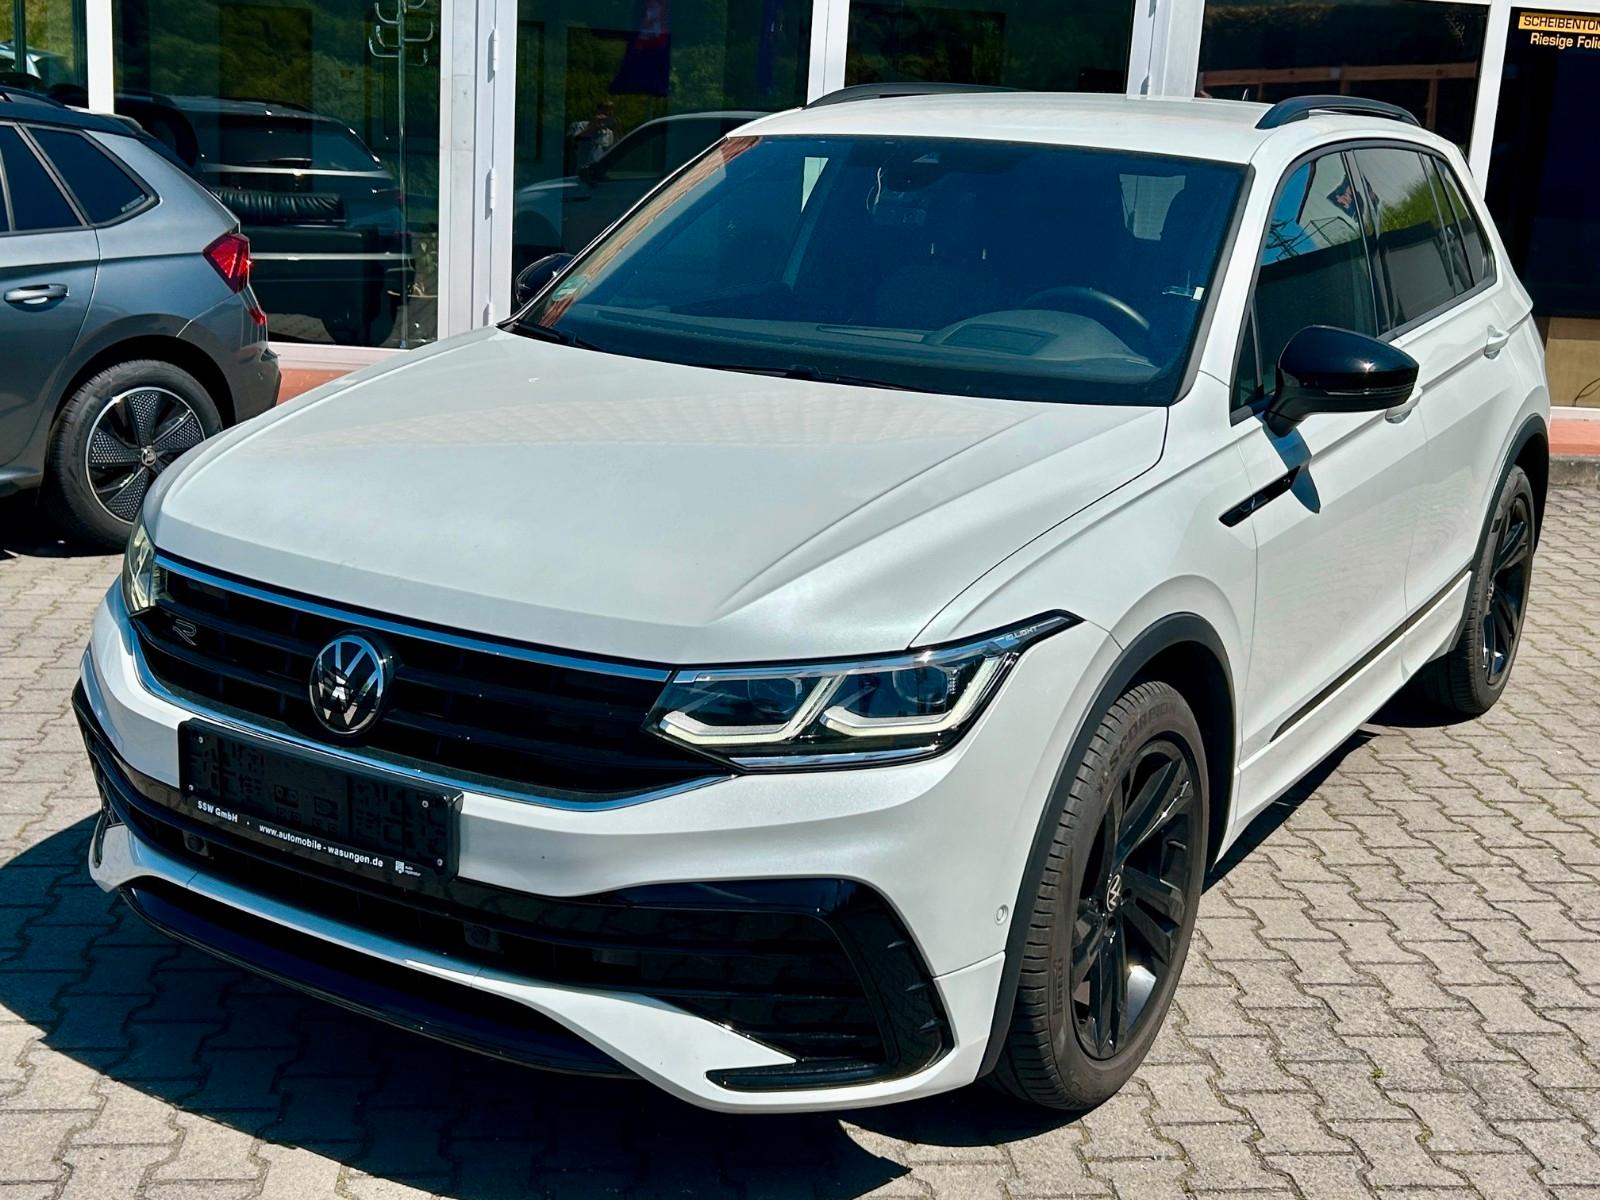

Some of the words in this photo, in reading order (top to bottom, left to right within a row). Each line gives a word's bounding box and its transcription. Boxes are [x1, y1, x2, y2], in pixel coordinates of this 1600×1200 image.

[1530, 32, 1573, 50] Riesige
[197, 800, 214, 814] SSW
[214, 808, 238, 823] GmbH
